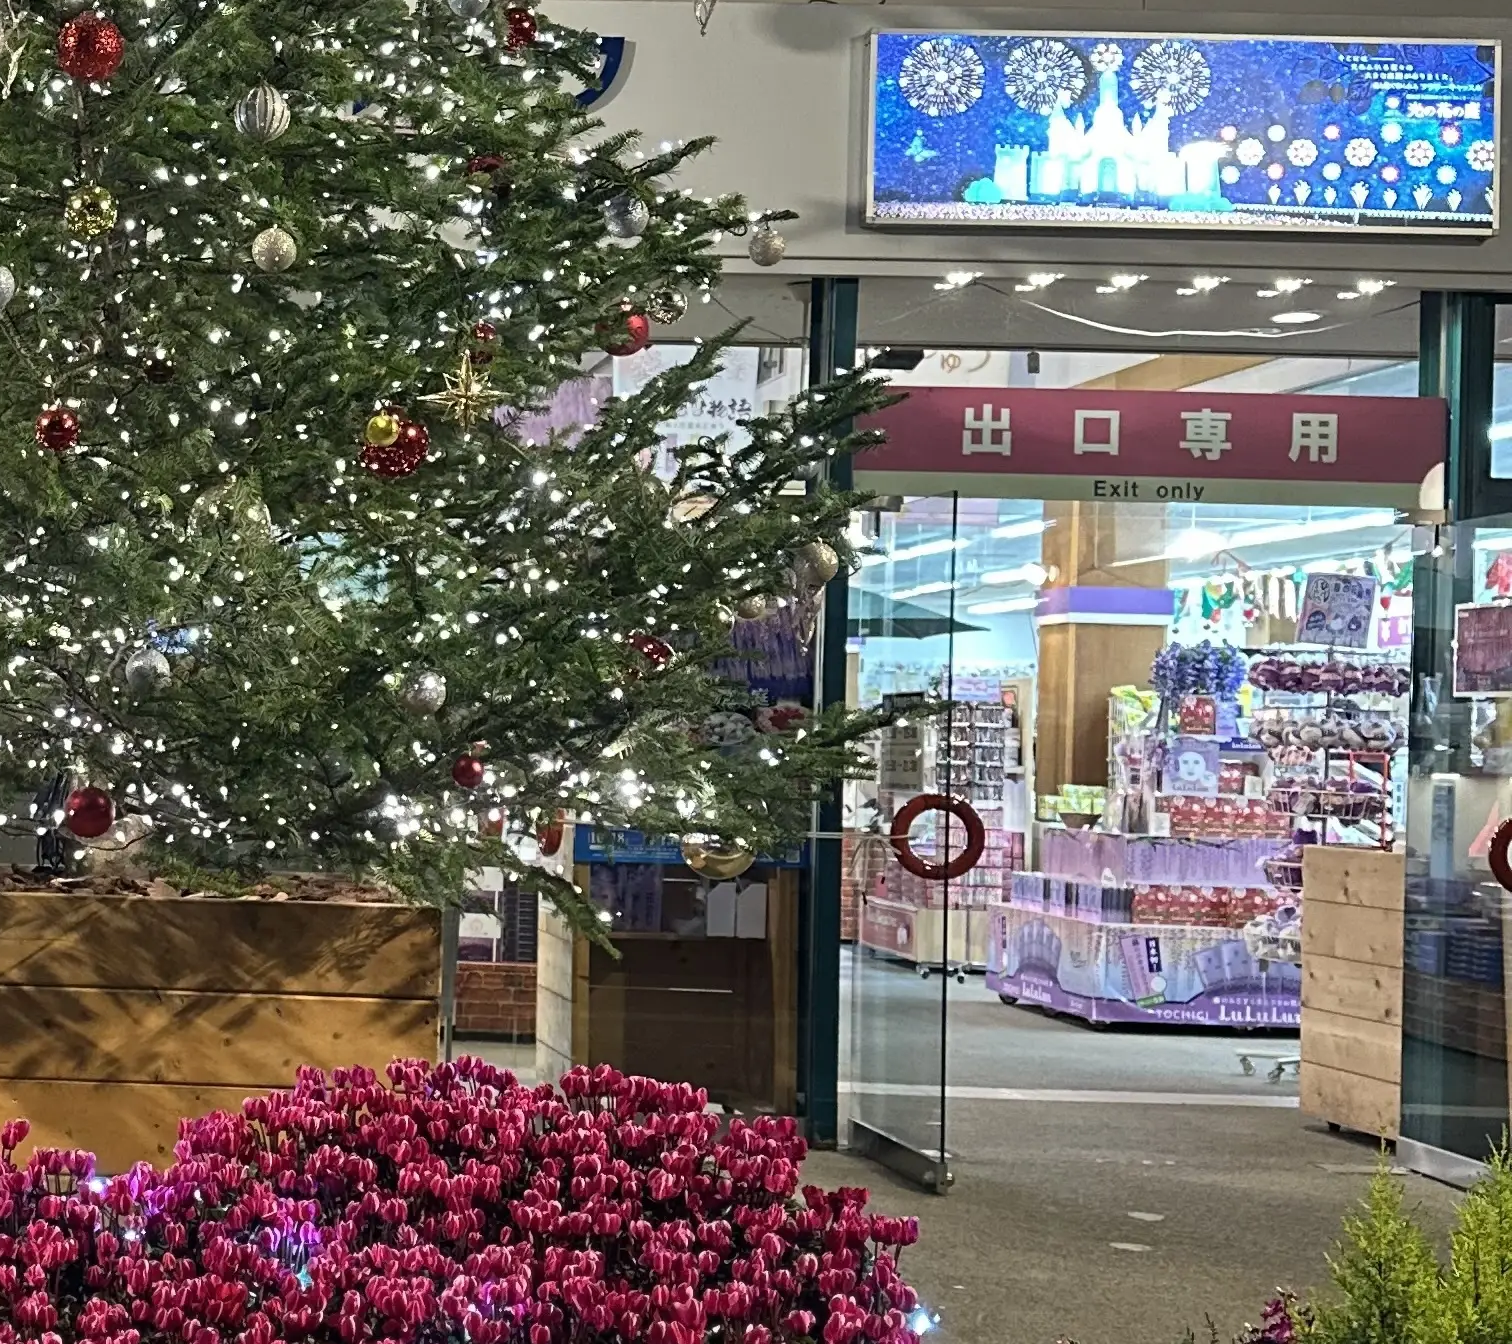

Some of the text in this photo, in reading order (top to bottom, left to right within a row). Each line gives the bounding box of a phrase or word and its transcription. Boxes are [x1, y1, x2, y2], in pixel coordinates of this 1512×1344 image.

[961, 403, 1339, 464] 出口専用
[1092, 479, 1205, 502] Exit only
